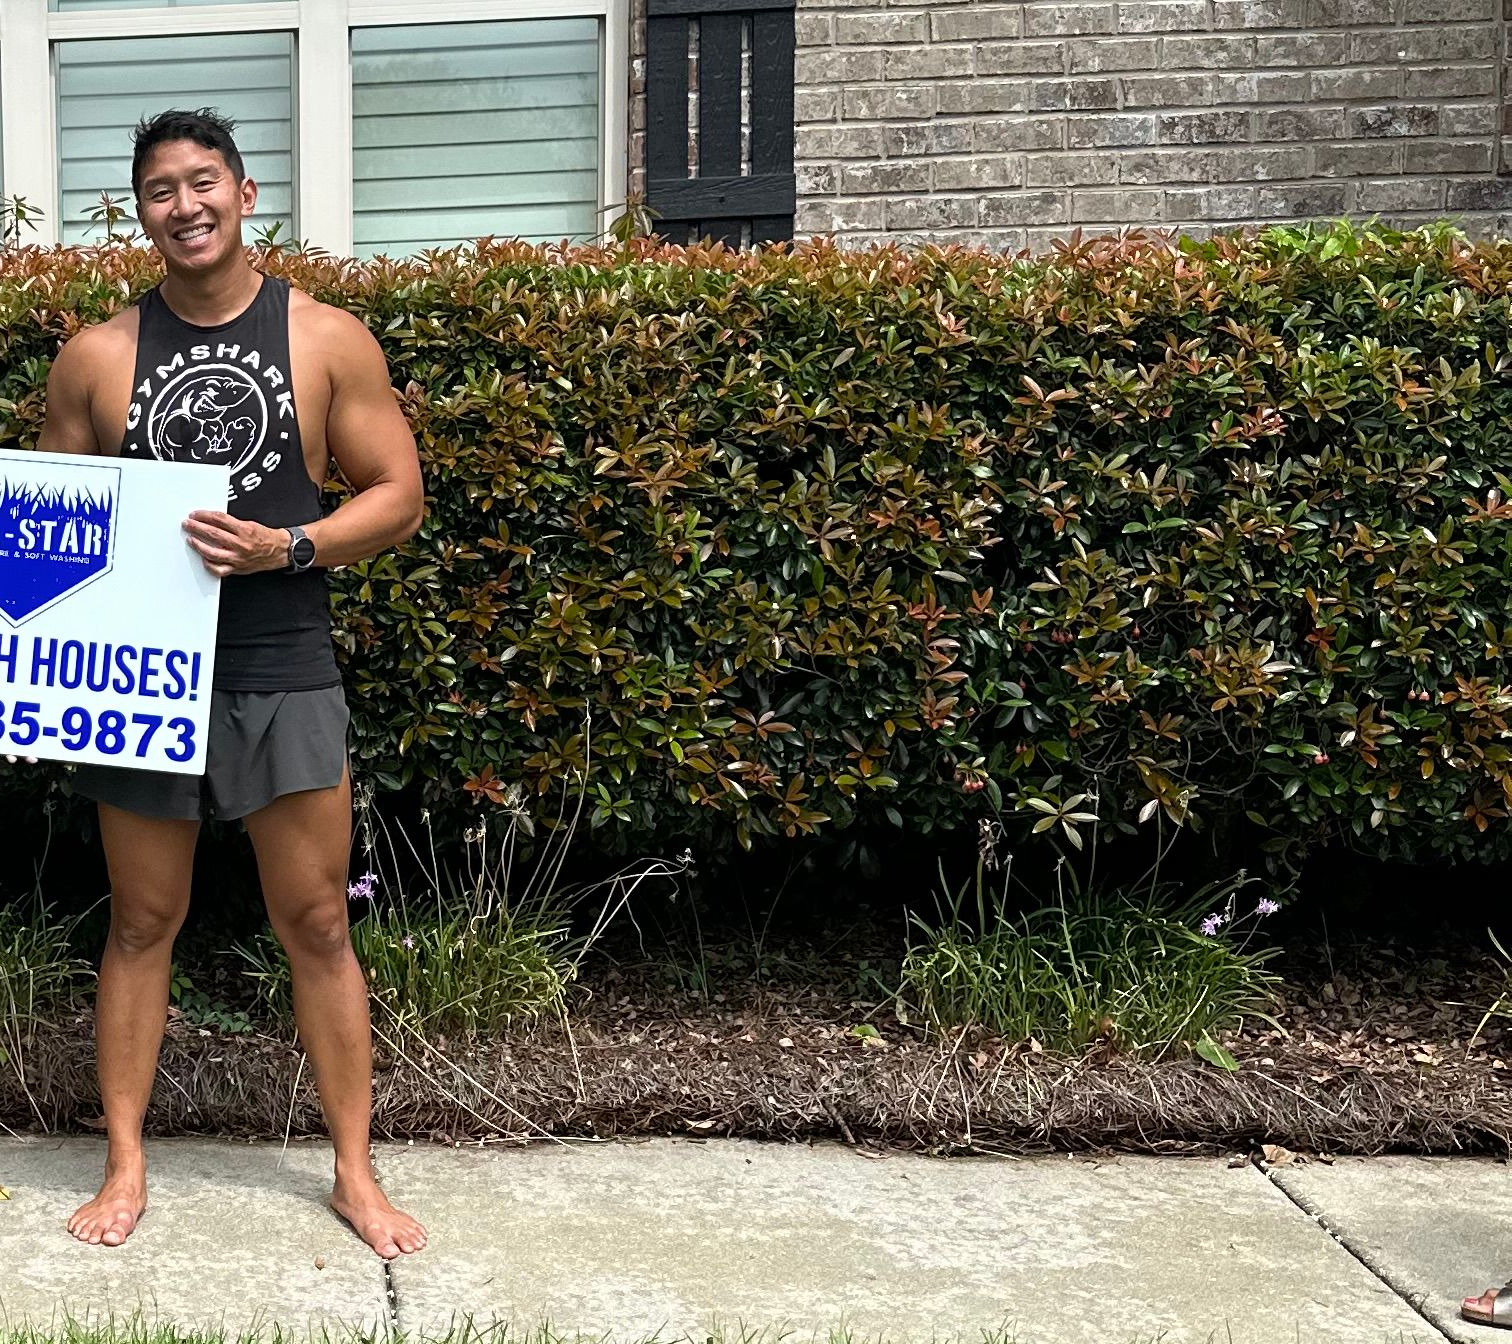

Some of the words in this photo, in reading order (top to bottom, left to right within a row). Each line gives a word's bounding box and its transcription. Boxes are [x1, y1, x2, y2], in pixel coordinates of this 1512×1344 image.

[126, 343, 295, 431] GYMSHARK
[13, 551, 20, 559] &
[24, 552, 45, 561] SOFT
[49, 554, 90, 565] WASHING
[30, 636, 202, 702] HOUSES!
